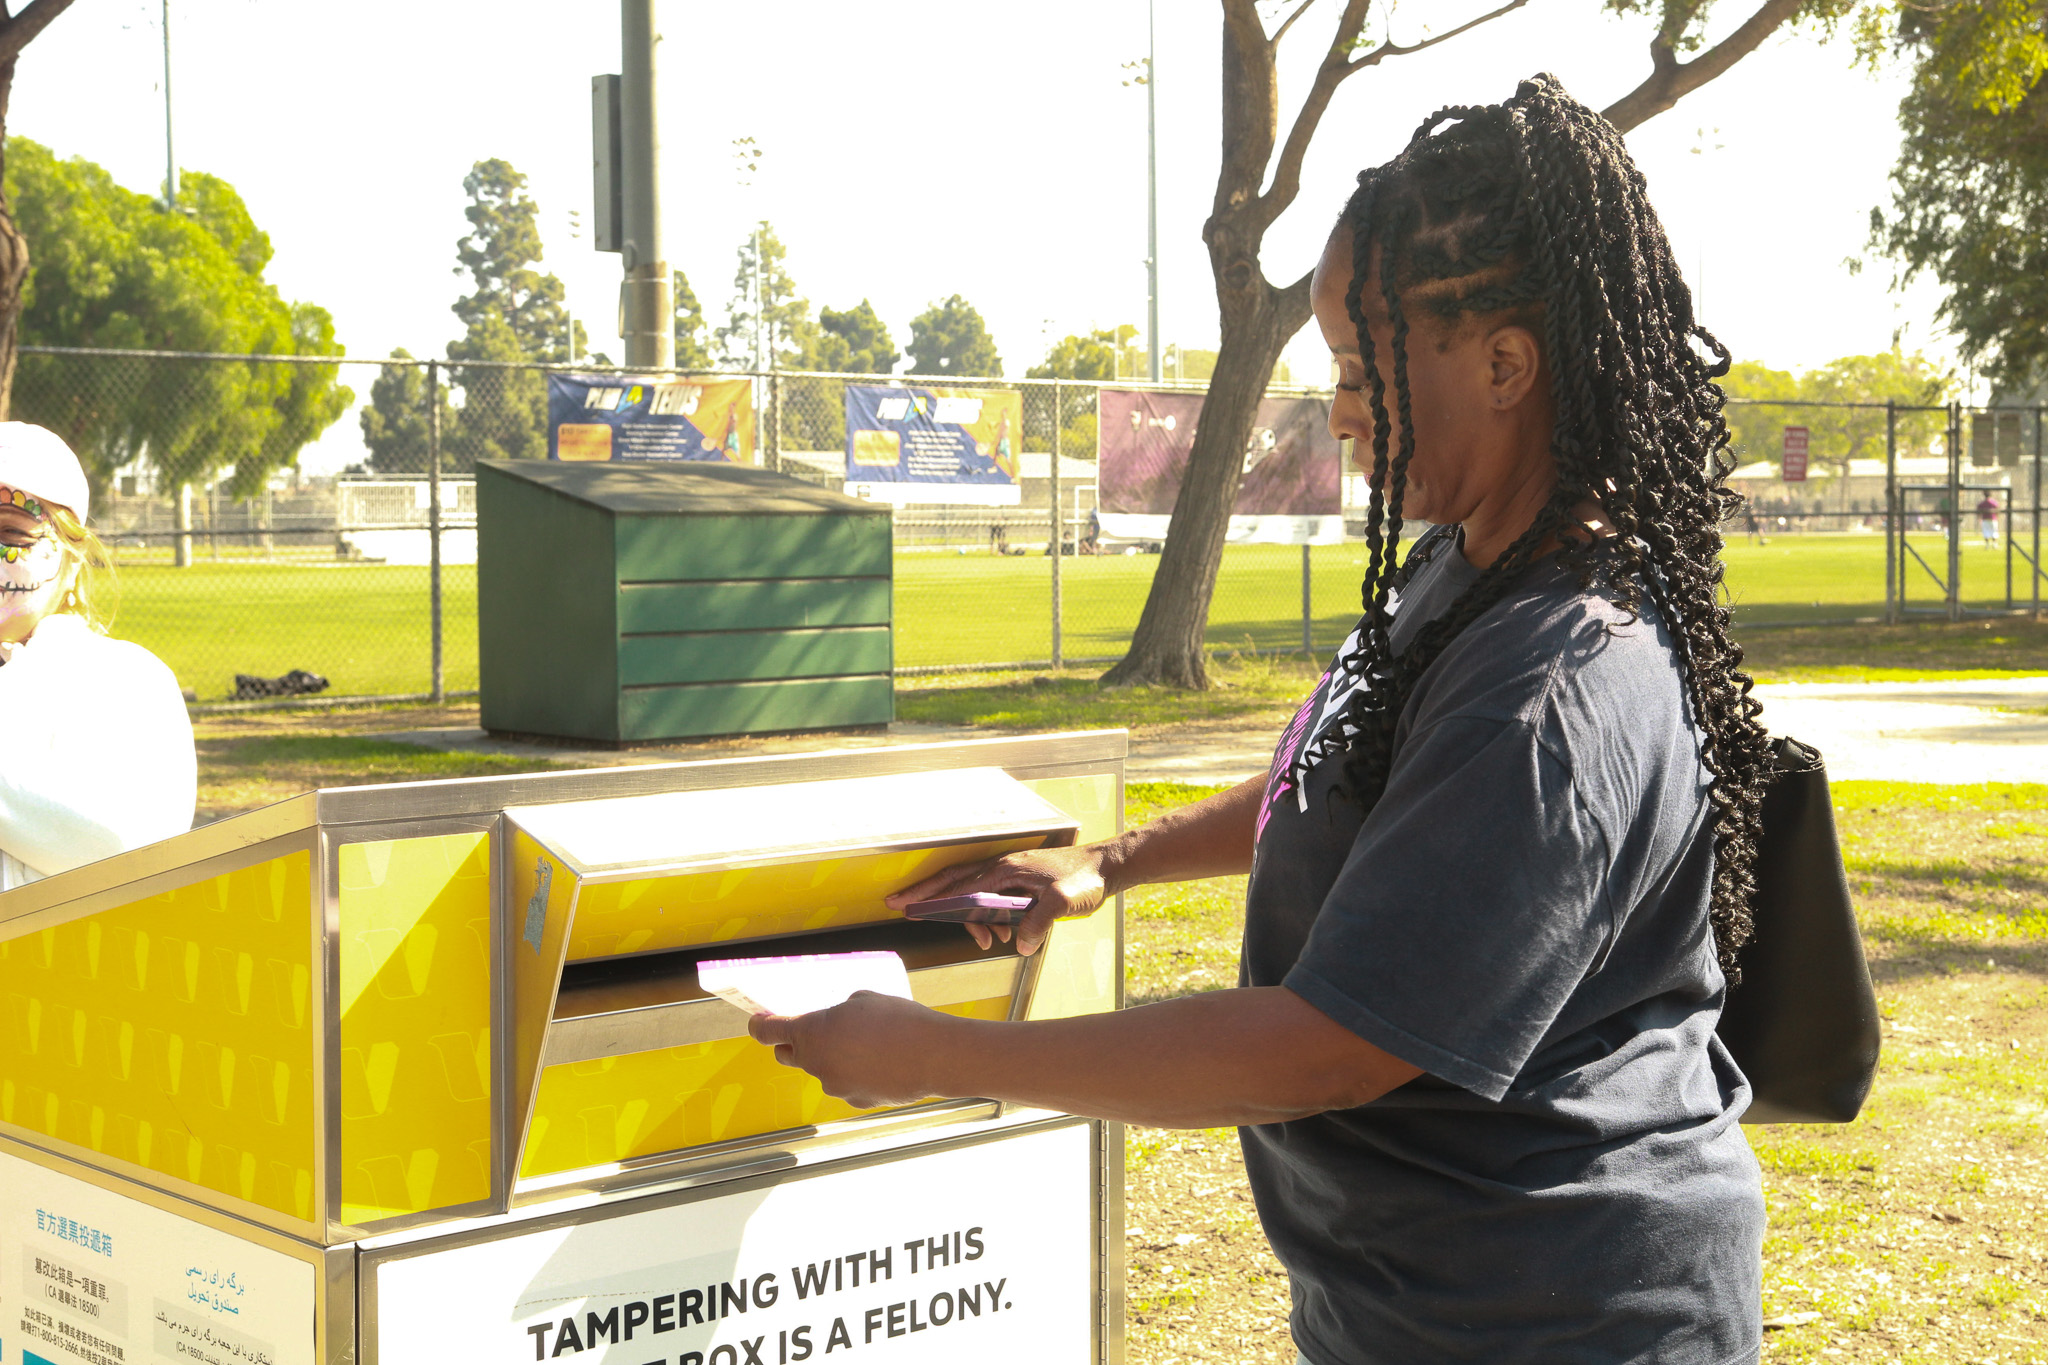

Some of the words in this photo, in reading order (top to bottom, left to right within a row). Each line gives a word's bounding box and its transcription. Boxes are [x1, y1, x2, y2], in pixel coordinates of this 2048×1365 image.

[78, 1297, 100, 1319] 18500)
[527, 1272, 779, 1362] TAMPERING
[791, 1246, 893, 1301] WITH
[903, 1226, 986, 1275] THIS
[779, 1326, 814, 1365] IS
[825, 1317, 852, 1355] A
[864, 1277, 1014, 1344] FELONY.
